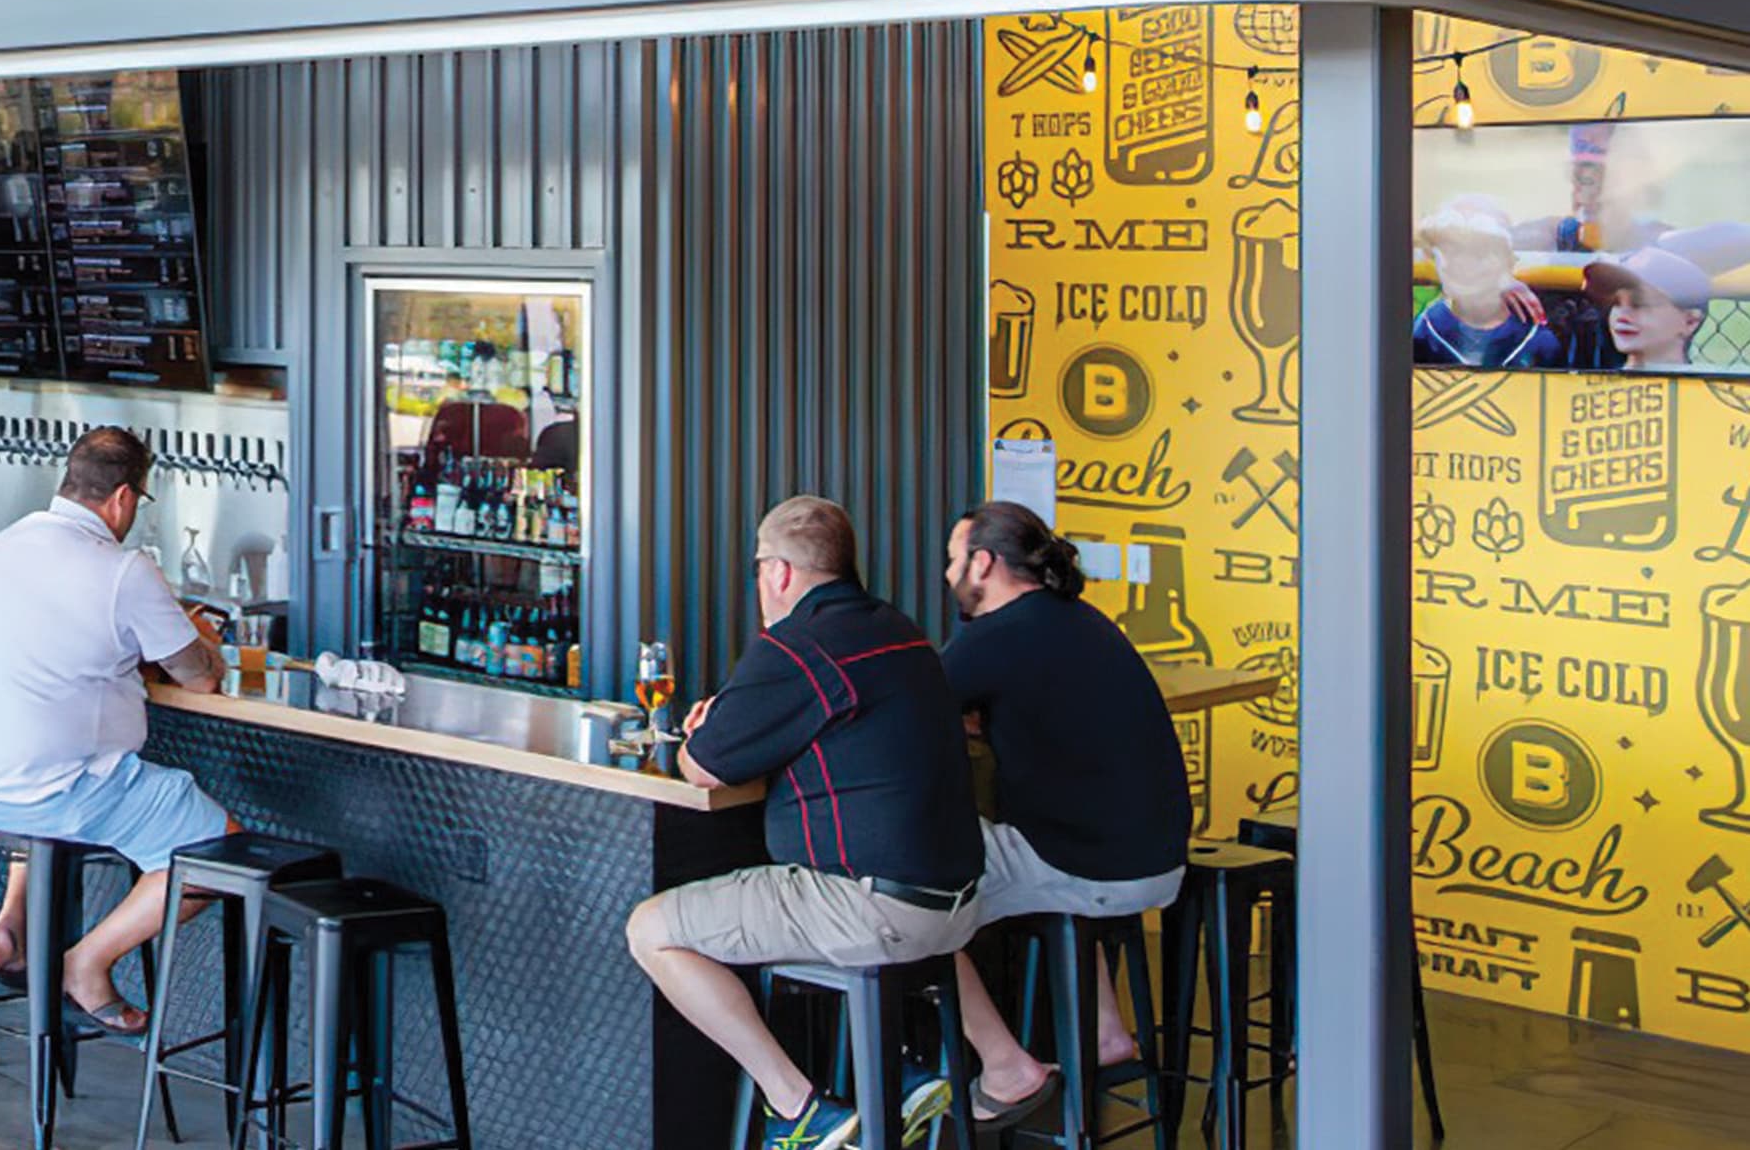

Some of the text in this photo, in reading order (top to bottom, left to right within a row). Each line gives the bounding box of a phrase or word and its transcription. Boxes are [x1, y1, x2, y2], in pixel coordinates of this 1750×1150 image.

[1055, 282, 1208, 330] ICE COLD
[1083, 362, 1129, 421] B
[1571, 382, 1663, 424] BEERS
[1585, 416, 1664, 456] GOOD
[1449, 452, 1522, 484] HOPS
[1551, 452, 1664, 494] CHEERS
[1476, 646, 1669, 717] ICE COLD
[1511, 740, 1571, 810] B
[1411, 794, 1649, 916] Beach
